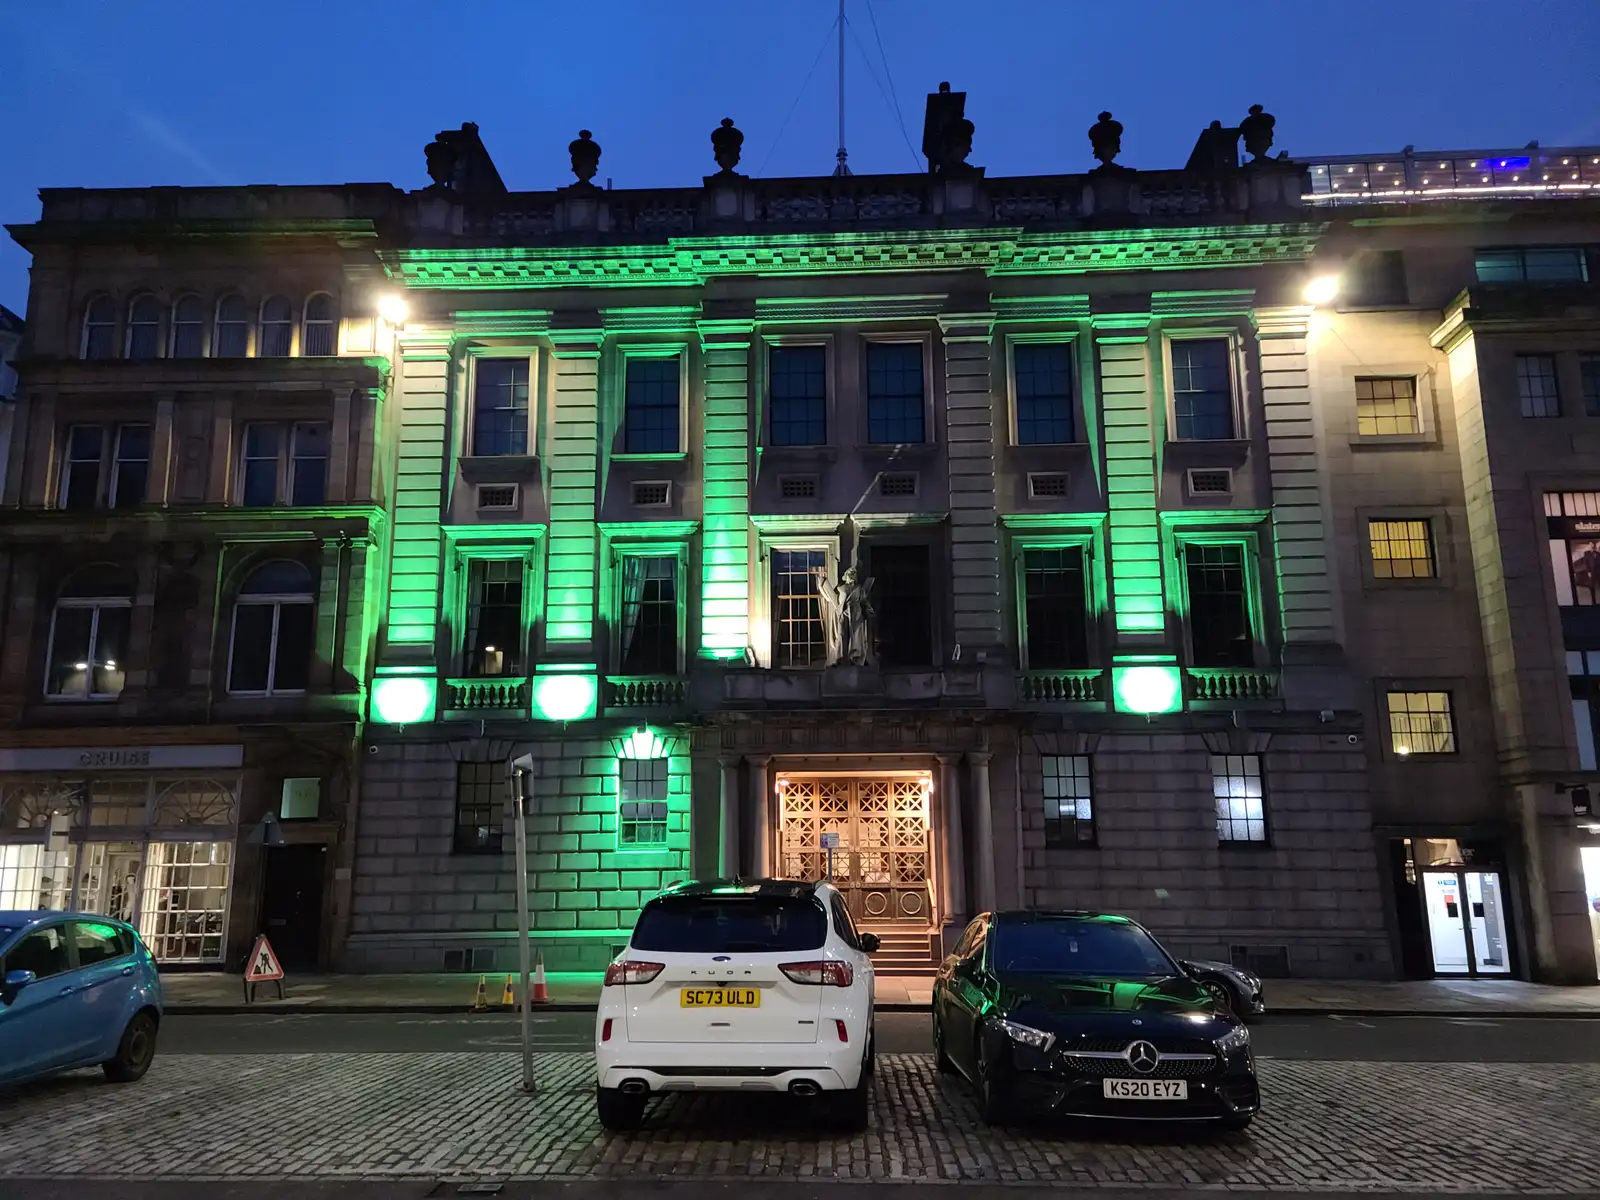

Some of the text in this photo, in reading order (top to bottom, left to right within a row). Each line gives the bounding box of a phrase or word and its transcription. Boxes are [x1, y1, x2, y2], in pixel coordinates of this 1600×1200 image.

[80, 750, 150, 766] CRUISE
[686, 991, 754, 1005] SC73 ULD
[1110, 1081, 1181, 1097] KS20 EYZ
